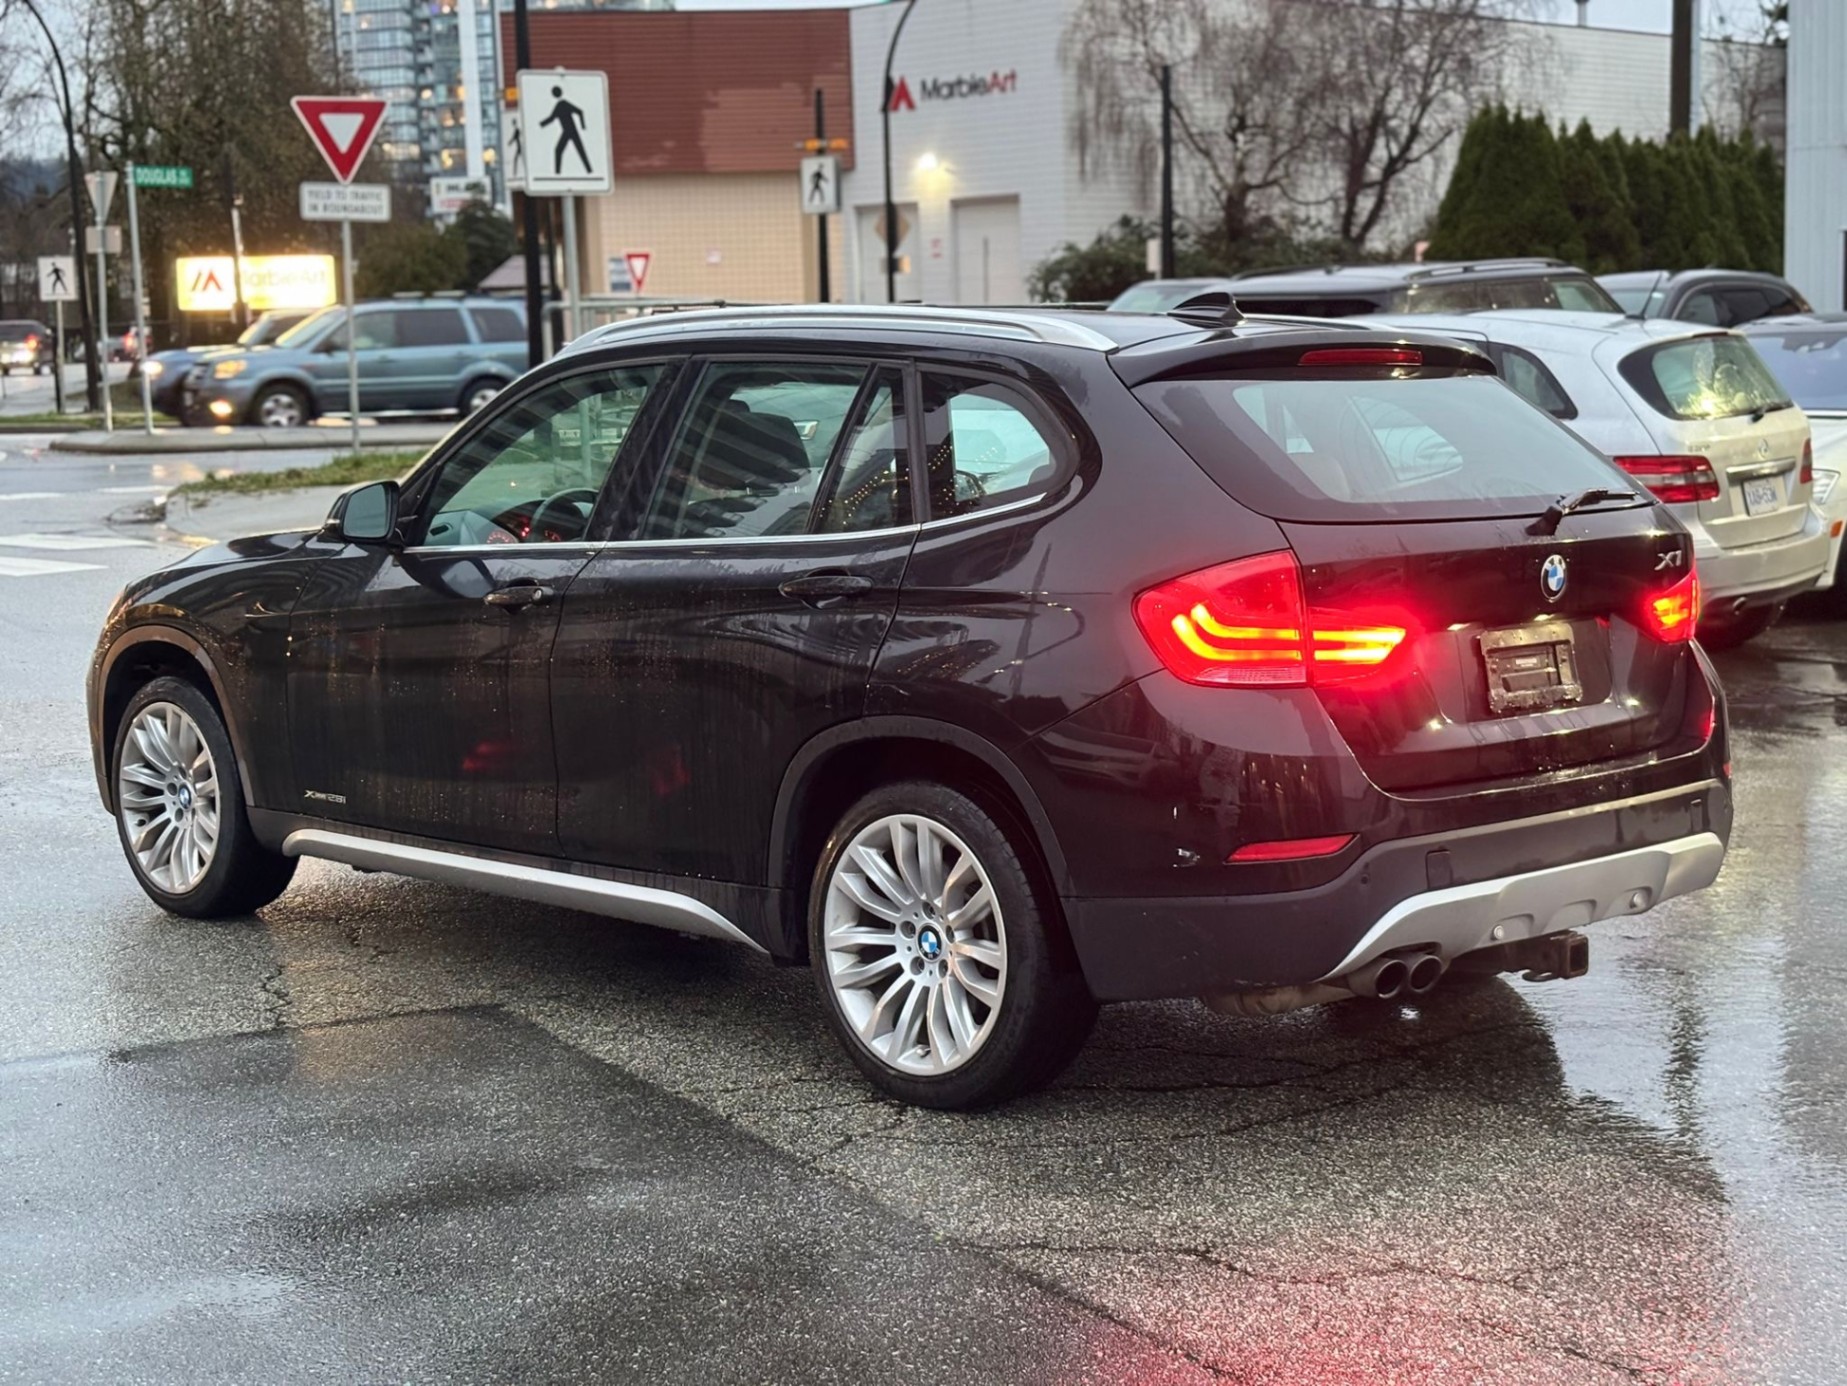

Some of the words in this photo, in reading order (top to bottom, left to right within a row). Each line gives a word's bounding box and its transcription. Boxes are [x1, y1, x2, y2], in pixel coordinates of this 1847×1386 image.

[920, 68, 1017, 101] MarbleArt
[136, 167, 178, 185] DOUGLAS
[307, 189, 332, 200] YIELD
[1654, 550, 1682, 571] X1
